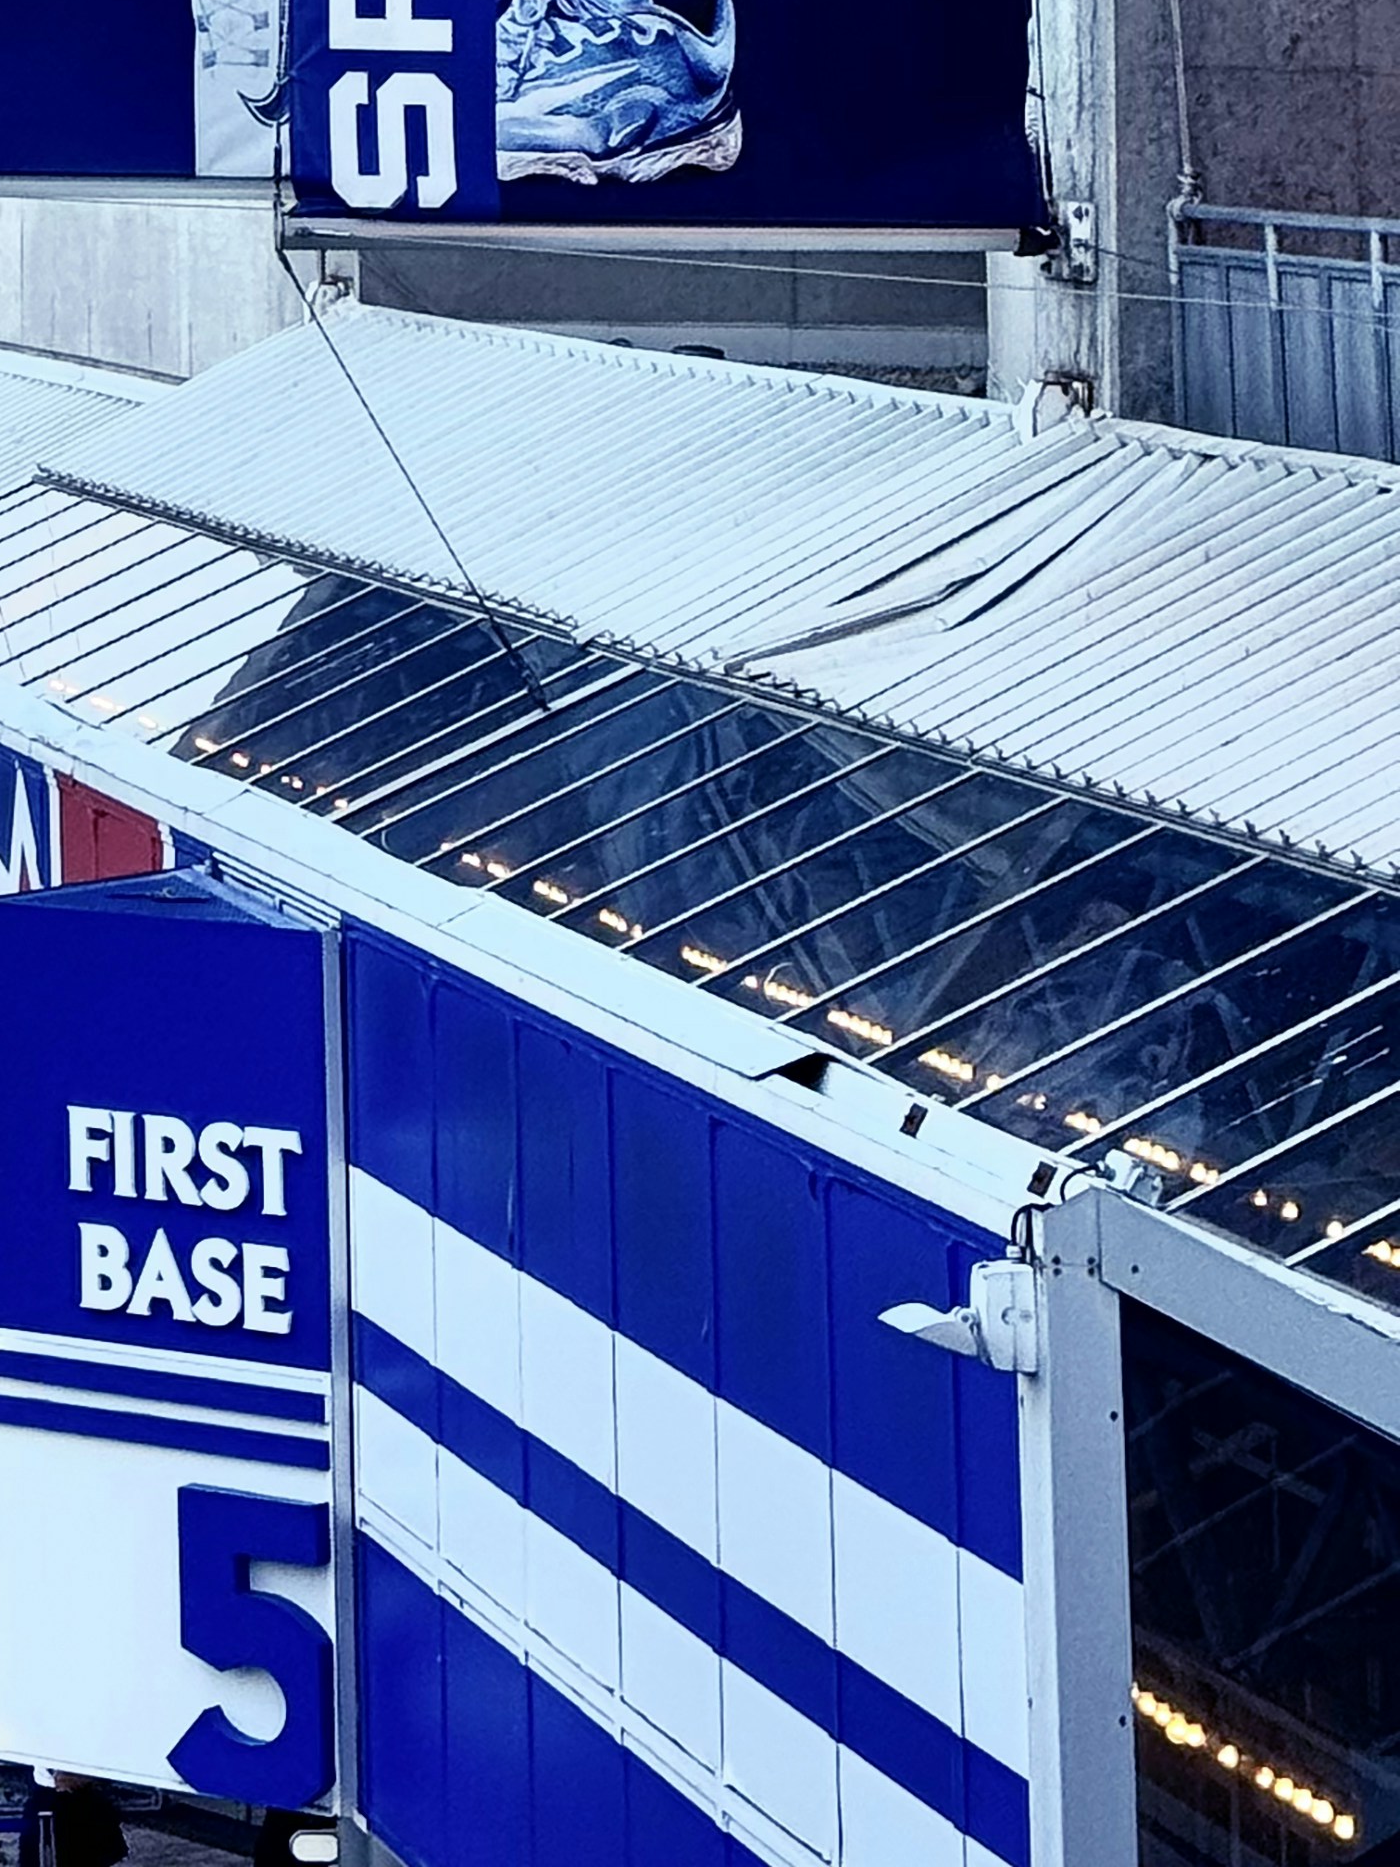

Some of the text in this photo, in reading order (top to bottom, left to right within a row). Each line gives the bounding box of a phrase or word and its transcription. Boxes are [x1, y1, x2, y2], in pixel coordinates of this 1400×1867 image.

[67, 1105, 303, 1217] FIRST
[79, 1221, 293, 1336] BASE
[166, 1482, 336, 1809] 5
